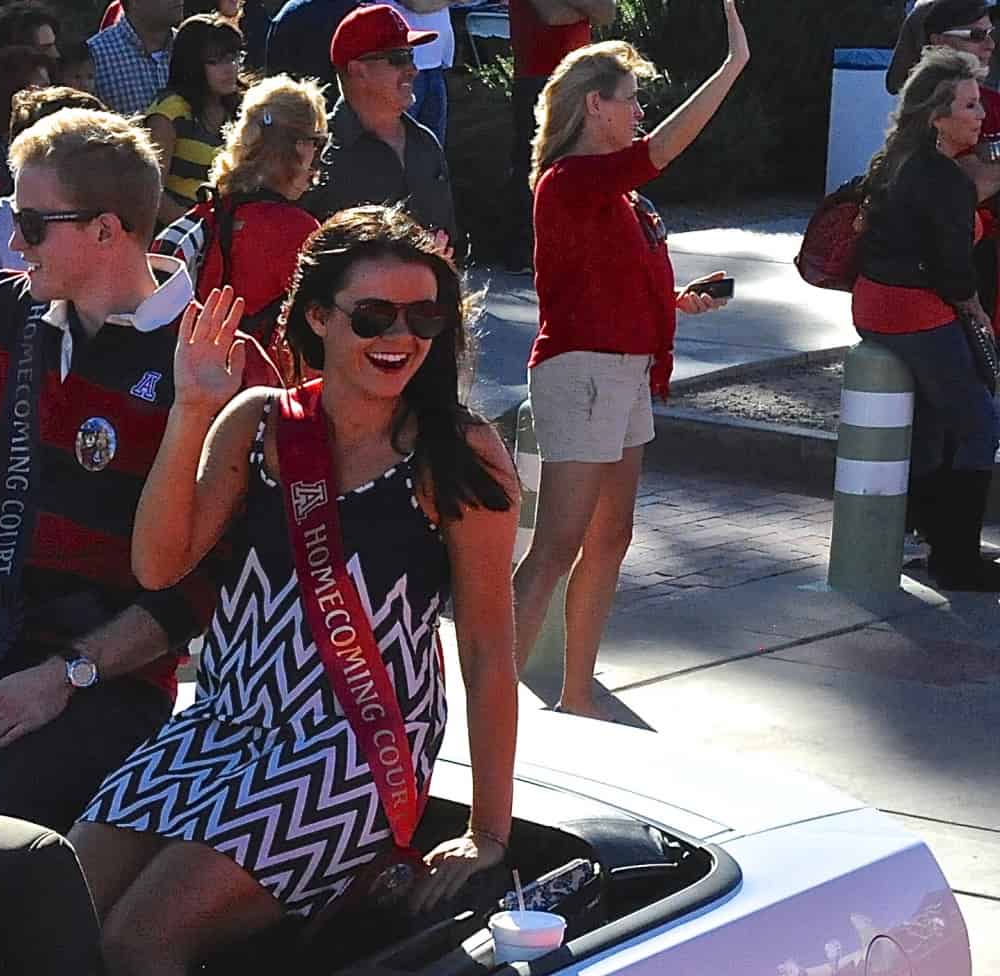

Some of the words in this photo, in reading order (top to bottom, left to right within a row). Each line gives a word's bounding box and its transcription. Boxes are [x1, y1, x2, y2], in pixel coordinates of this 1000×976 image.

[5, 304, 46, 491] HOMECOMING
[130, 371, 162, 402] A
[304, 523, 386, 723] HOMECOMING
[373, 729, 409, 810] COUR
